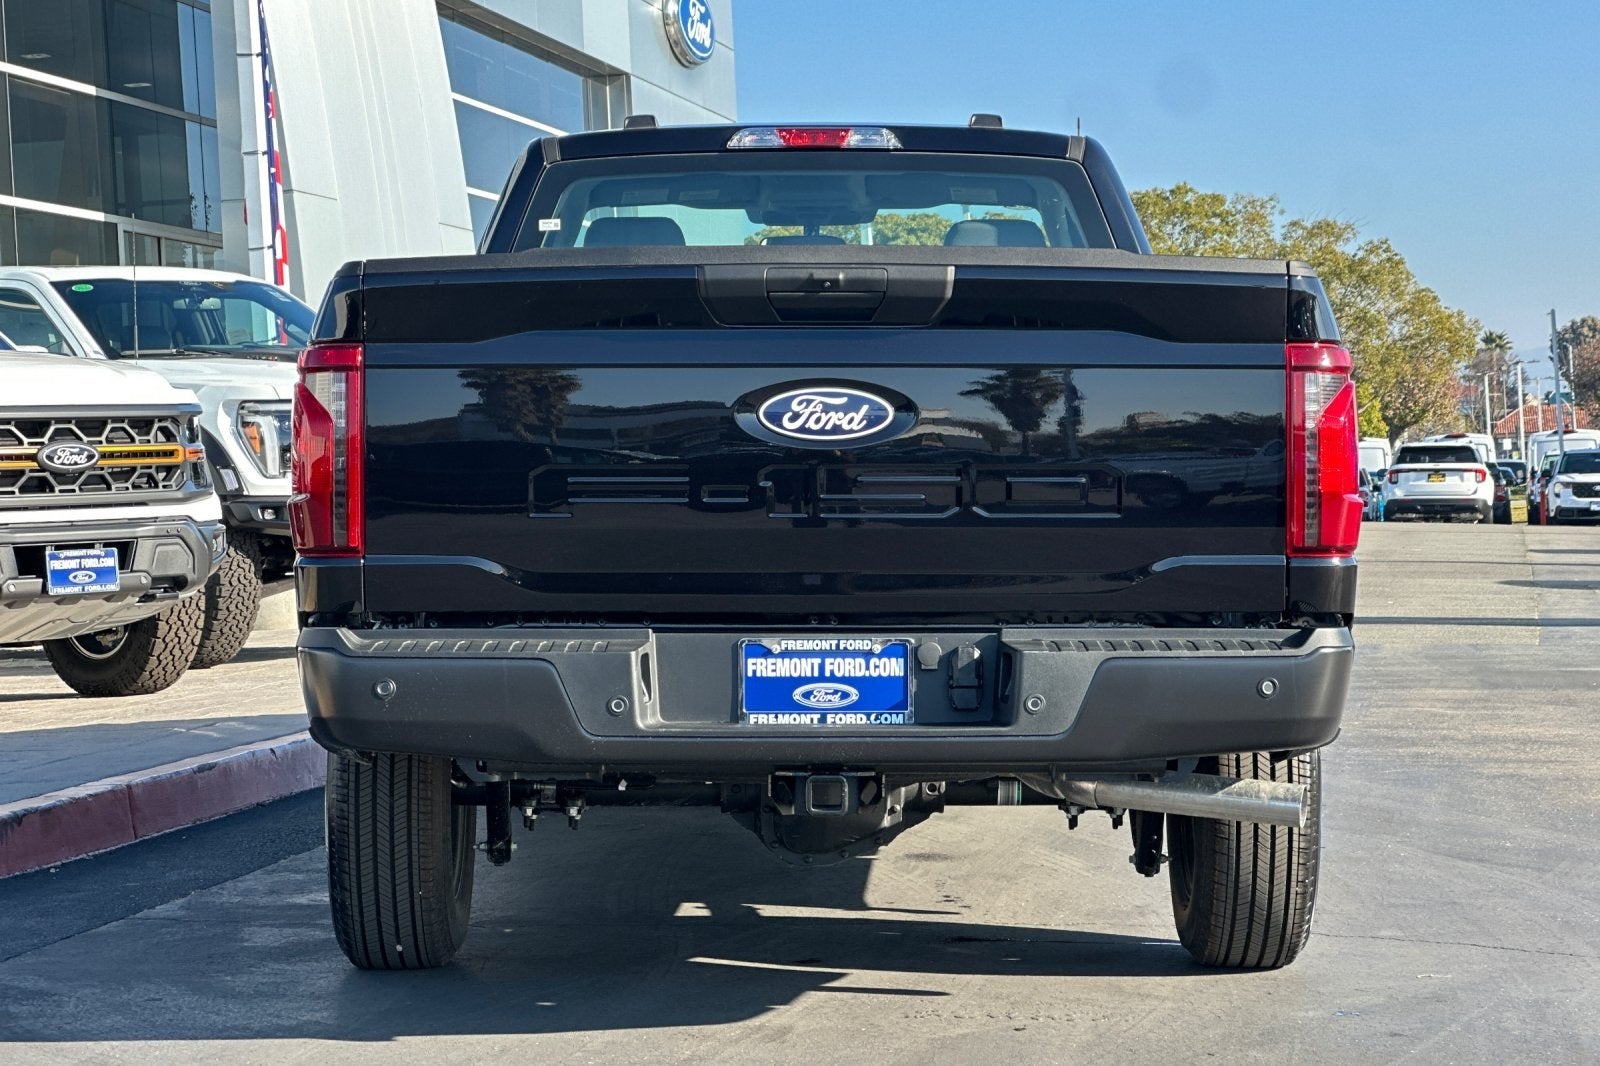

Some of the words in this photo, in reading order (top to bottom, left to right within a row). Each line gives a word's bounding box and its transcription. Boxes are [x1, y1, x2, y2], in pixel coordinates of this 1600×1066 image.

[687, 0, 712, 48] Ford
[782, 395, 869, 430] Ford
[53, 447, 88, 464] Ford
[51, 559, 80, 570] FREMONT
[81, 557, 115, 568] FORD.COM
[781, 640, 837, 650] FREMONT
[840, 640, 871, 650] FORD
[747, 658, 821, 677] FREMONT
[824, 658, 904, 677] FORD.COM
[810, 688, 841, 702] Ford
[749, 713, 820, 724] FREMONT
[827, 713, 903, 724] FORD.COM
